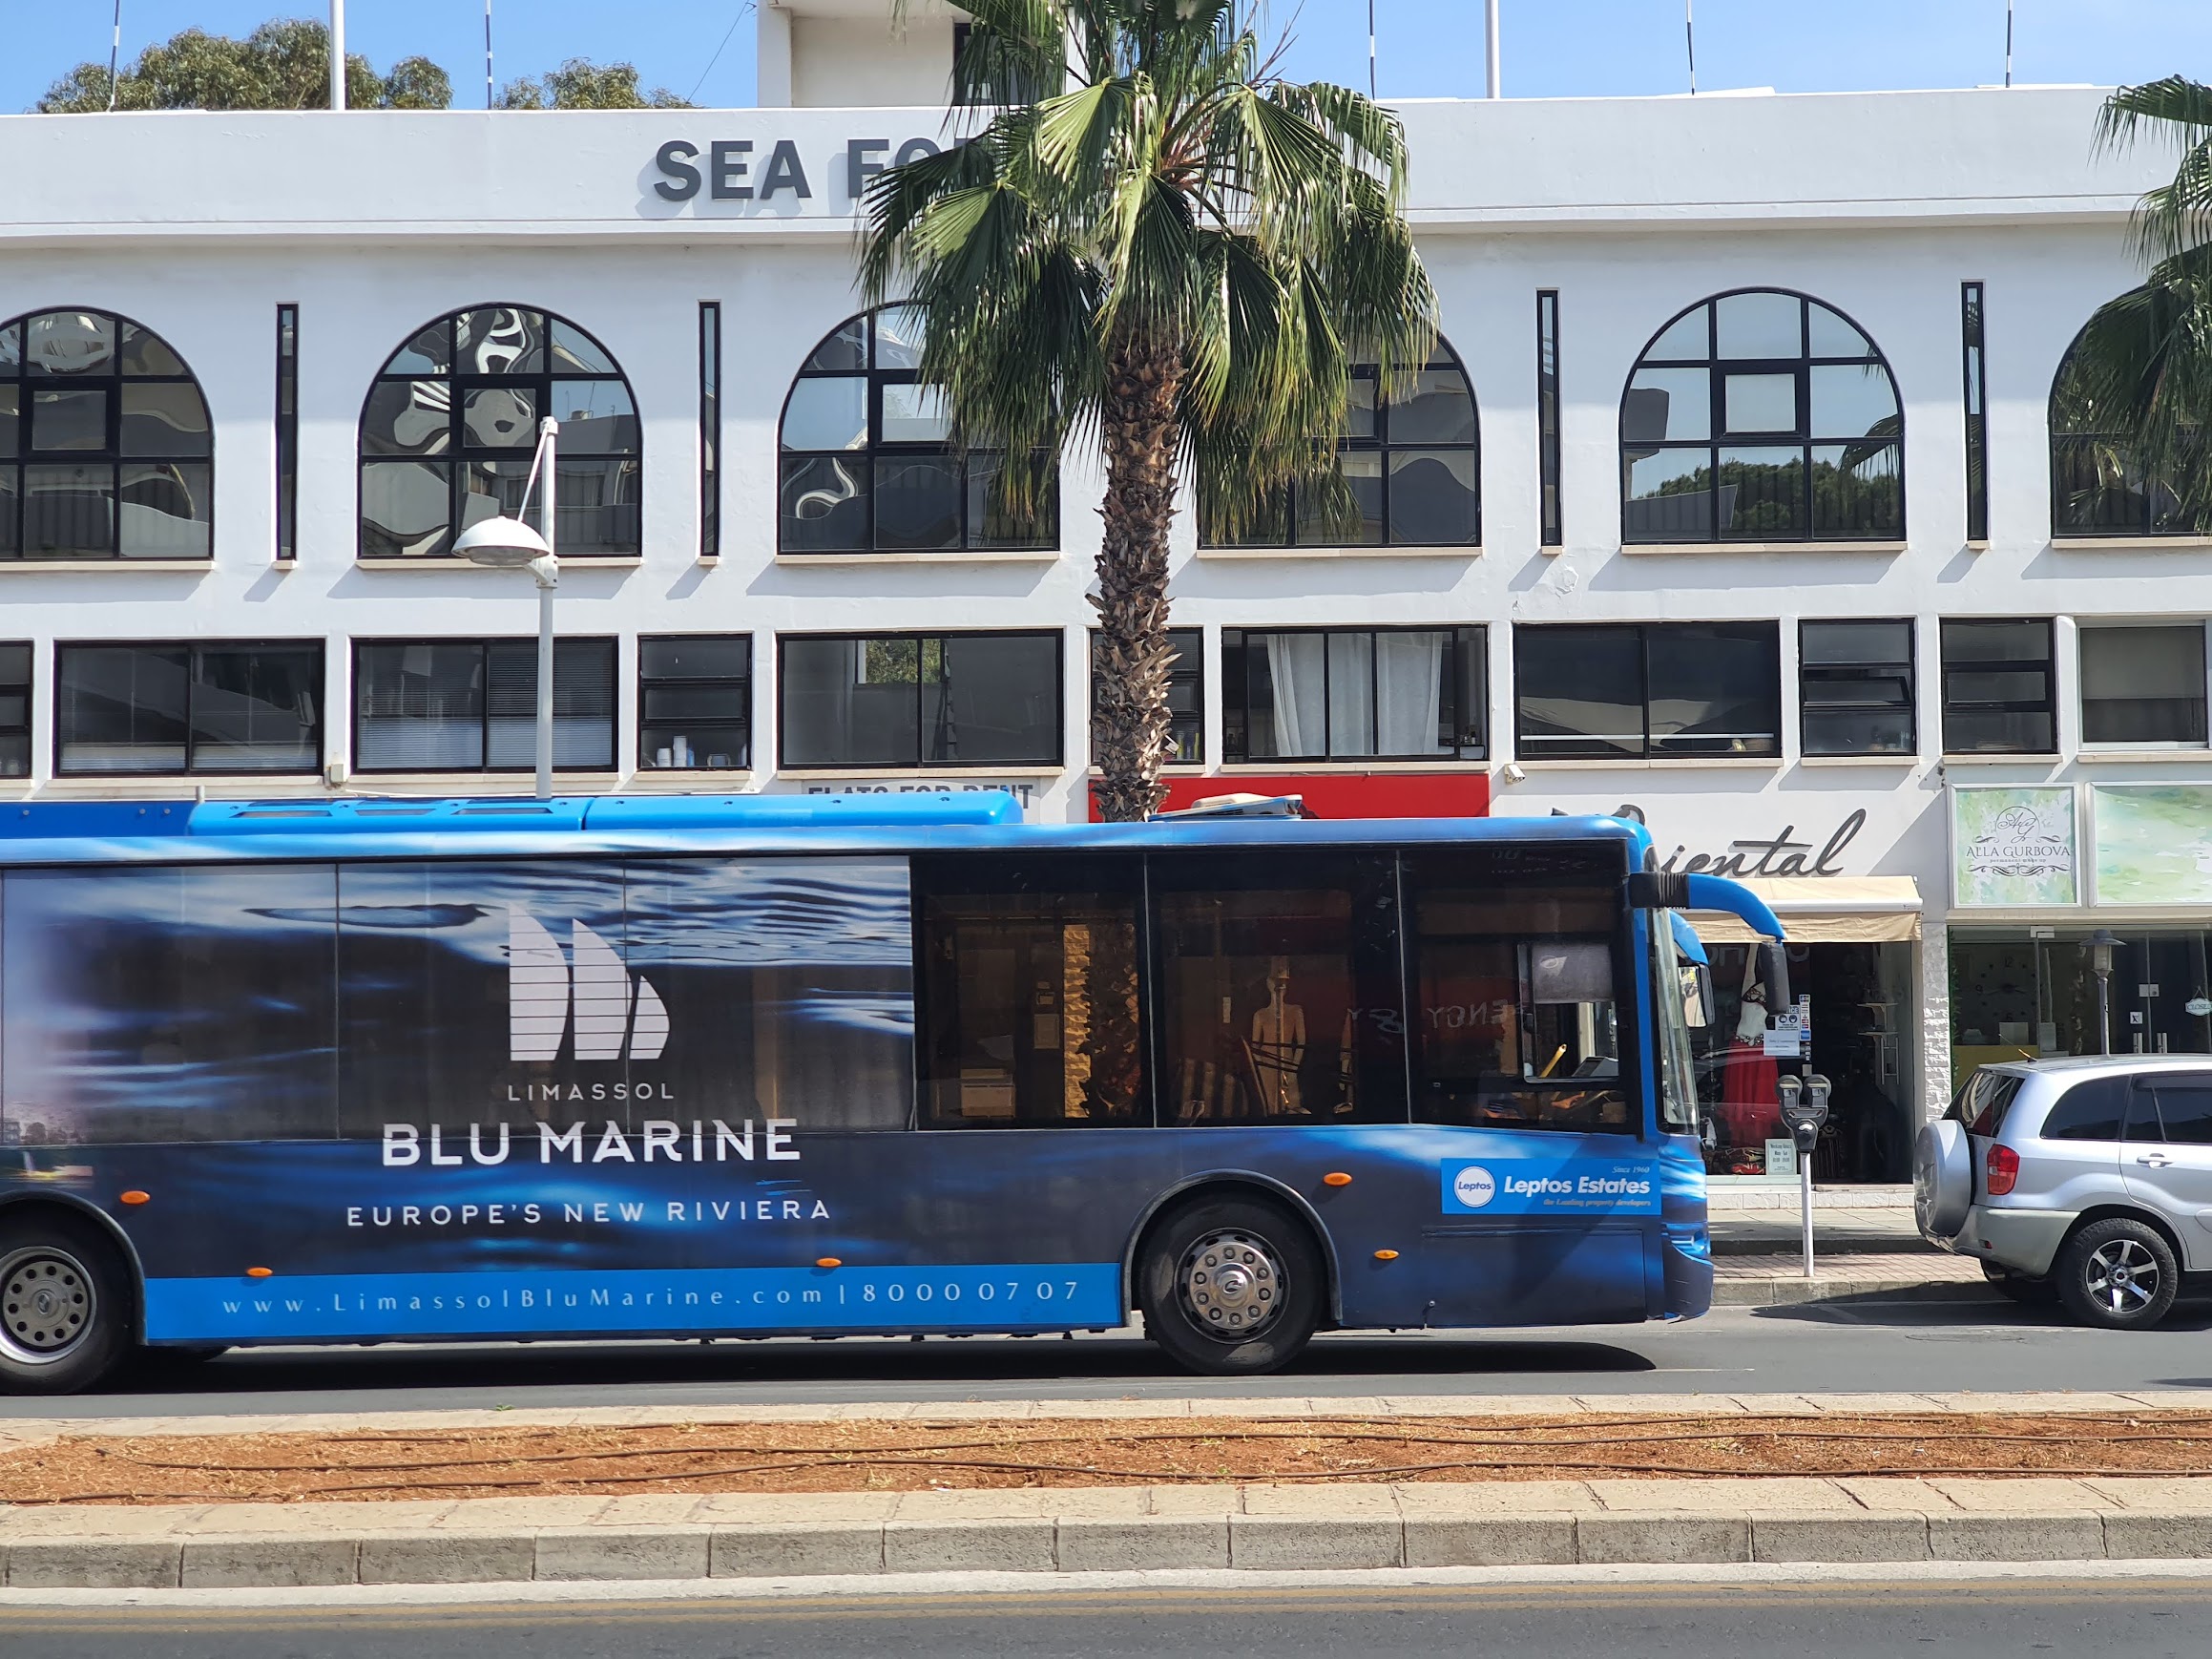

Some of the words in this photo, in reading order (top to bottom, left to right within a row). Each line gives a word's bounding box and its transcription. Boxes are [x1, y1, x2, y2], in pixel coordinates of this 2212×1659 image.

[654, 139, 812, 201] SEA
[2002, 846, 2071, 859] GURBOVA
[508, 1082, 675, 1102] LIMASSOL
[383, 1123, 510, 1166] BLU
[536, 1118, 801, 1164] MARINE
[1458, 1181, 1492, 1193] Leptos
[1504, 1176, 1573, 1198] Leptos
[1577, 1176, 1651, 1194] Estates
[347, 1203, 541, 1227] EUROPE'S
[565, 1202, 644, 1223] NEW
[668, 1199, 830, 1222] RIVIERA
[978, 1282, 1018, 1301] 07
[1036, 1281, 1077, 1300] 07
